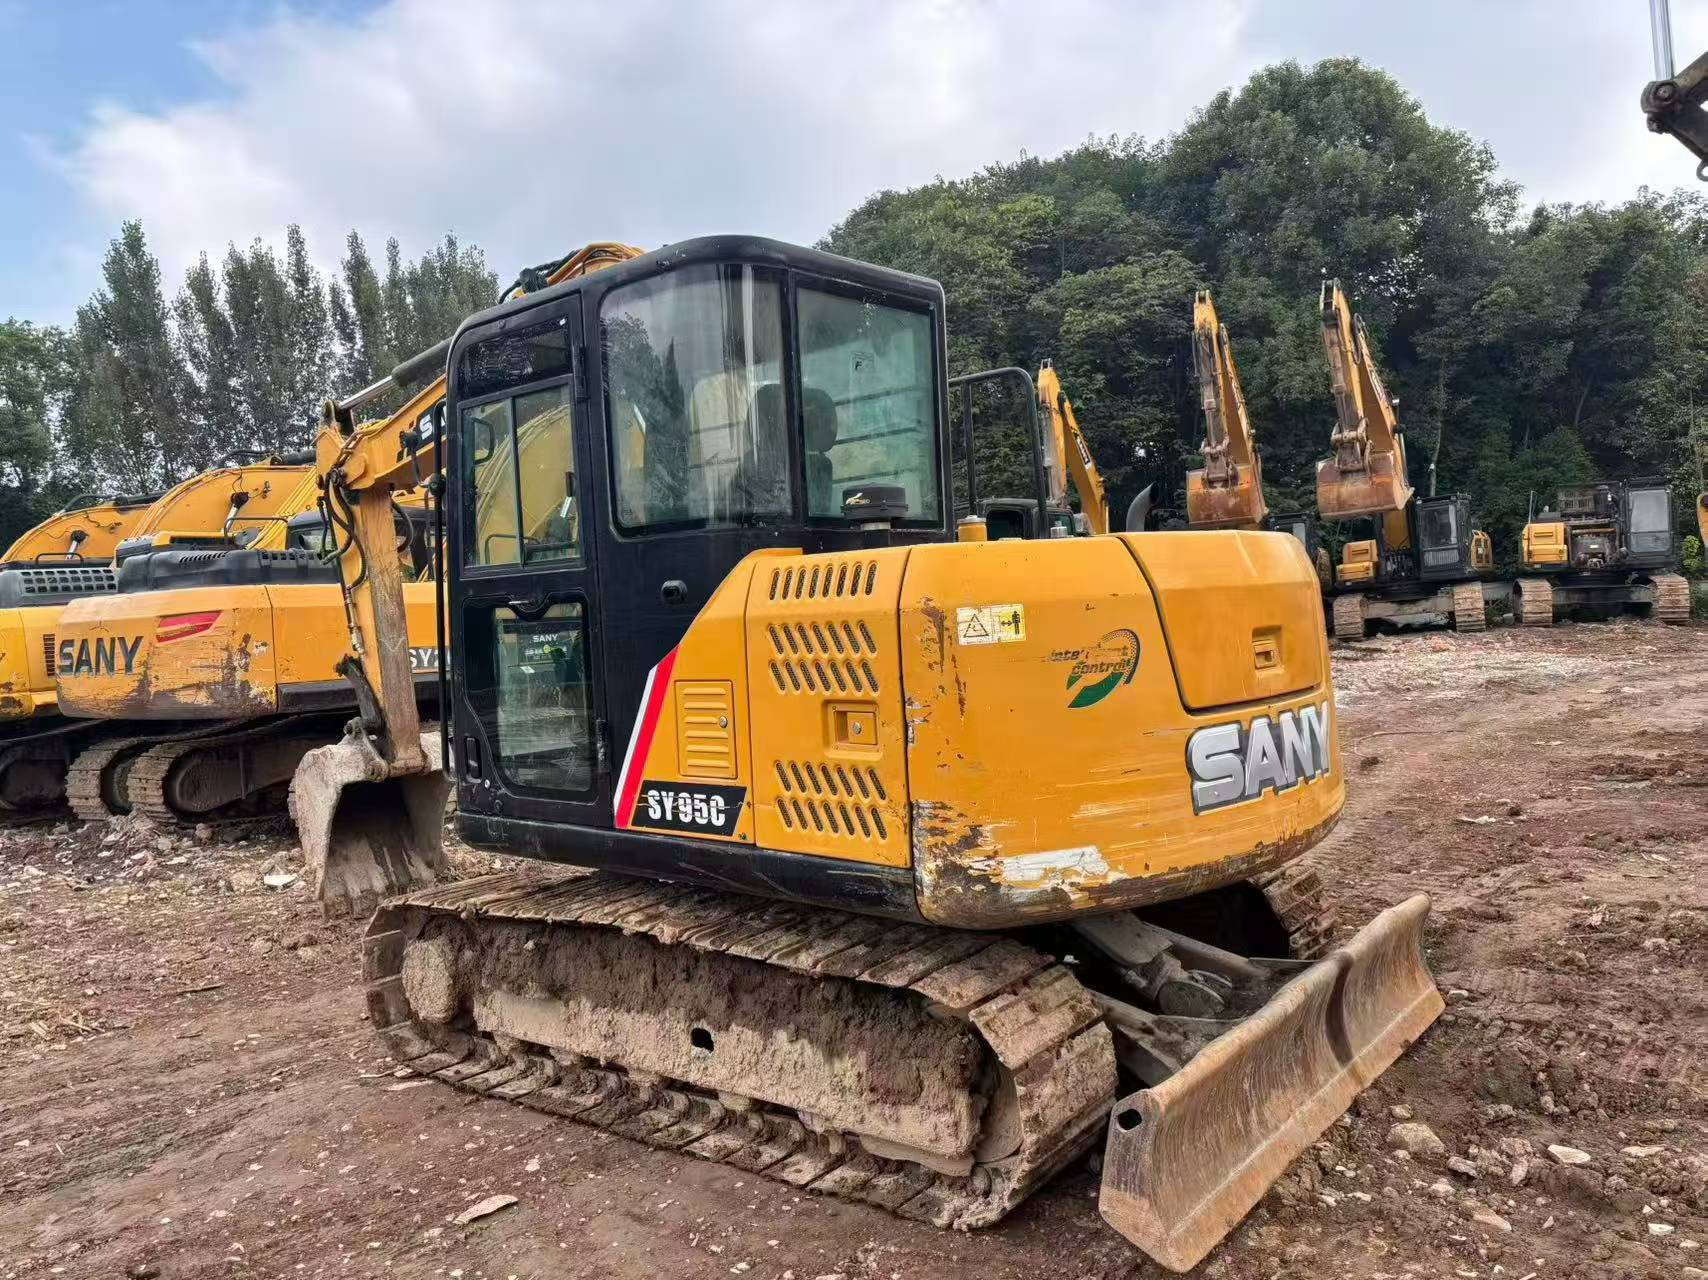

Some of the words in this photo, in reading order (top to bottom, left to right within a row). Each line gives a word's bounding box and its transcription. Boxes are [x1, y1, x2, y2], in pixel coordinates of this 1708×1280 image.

[59, 636, 144, 677] SANY
[532, 633, 558, 643] SANY
[1186, 700, 1330, 811] SANY
[647, 789, 726, 827] SY95C
